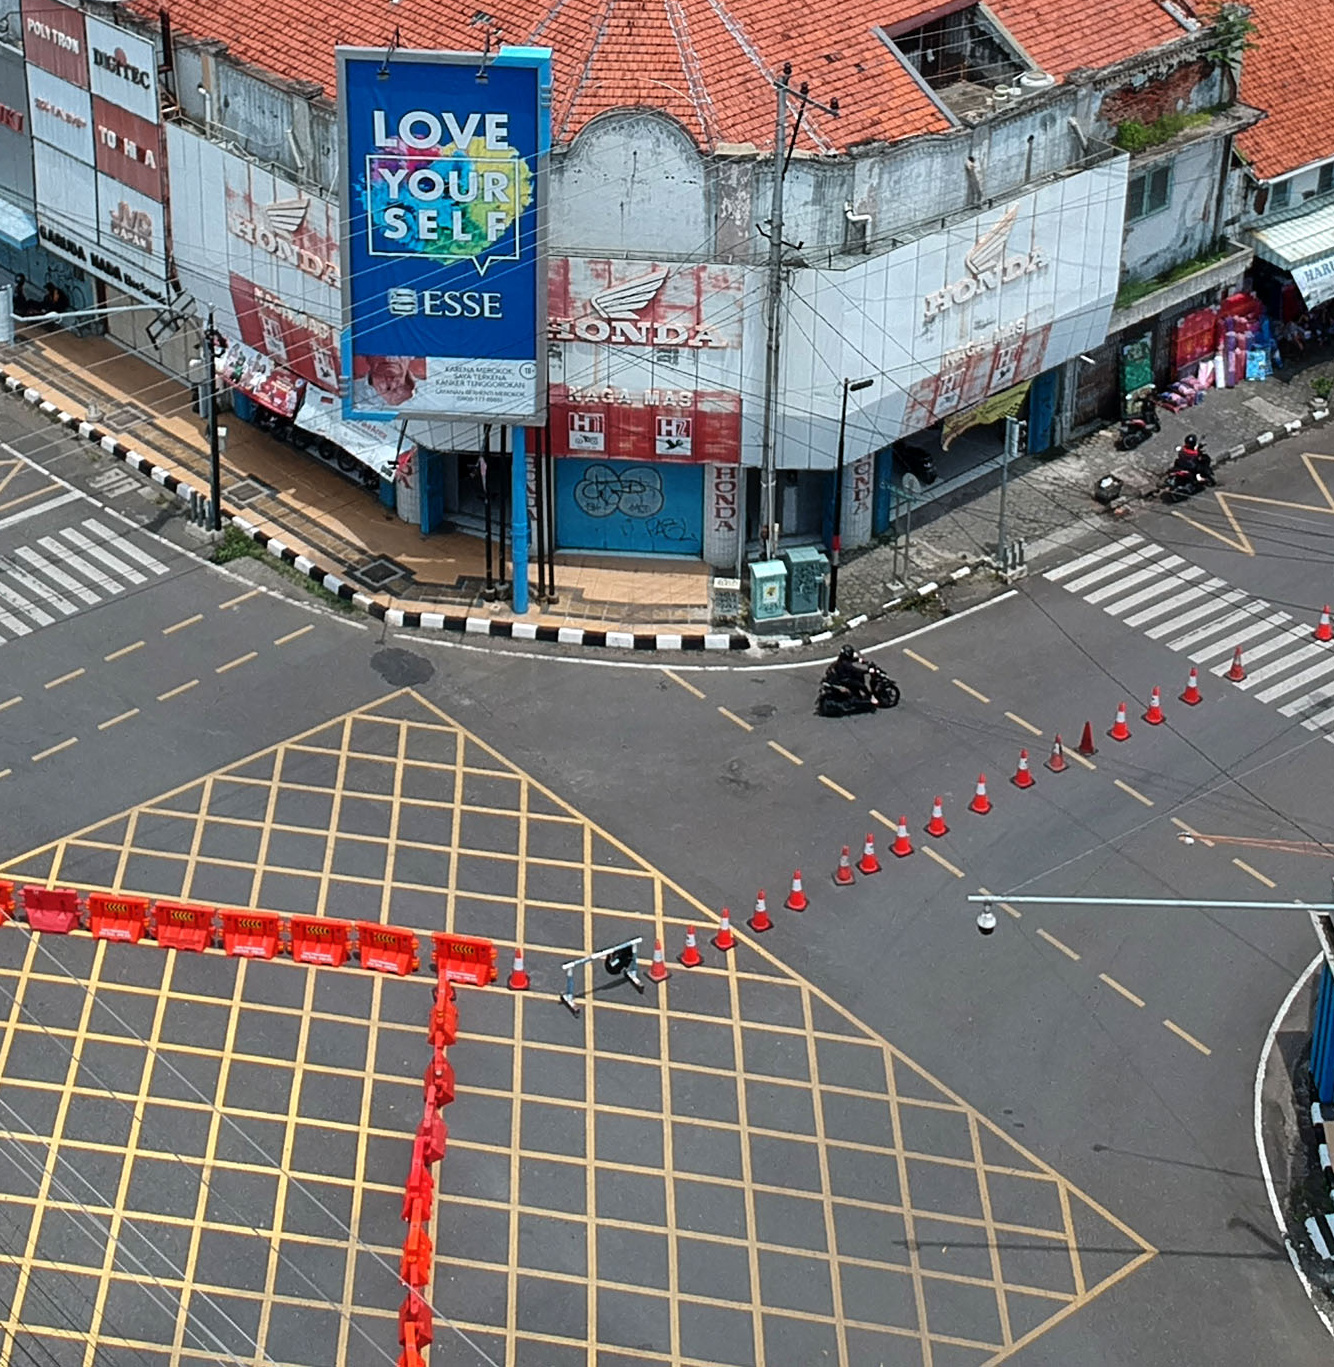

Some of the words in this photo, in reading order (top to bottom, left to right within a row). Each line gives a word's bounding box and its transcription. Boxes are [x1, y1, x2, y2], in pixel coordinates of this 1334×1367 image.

[93, 46, 151, 90] DIGITEC
[373, 110, 509, 150] LOVE
[379, 169, 510, 202] YOUR
[383, 207, 507, 242] SELF
[230, 213, 341, 289] HONDA
[923, 246, 1053, 319] HONDA
[423, 290, 503, 318] ESSE
[547, 317, 728, 347] HONDA
[944, 336, 985, 368] NAGA
[993, 318, 1026, 344] MAS
[569, 386, 632, 405] NAGA
[644, 390, 694, 408] MAS
[714, 466, 737, 532] HONDA
[852, 453, 872, 516] ONDA
